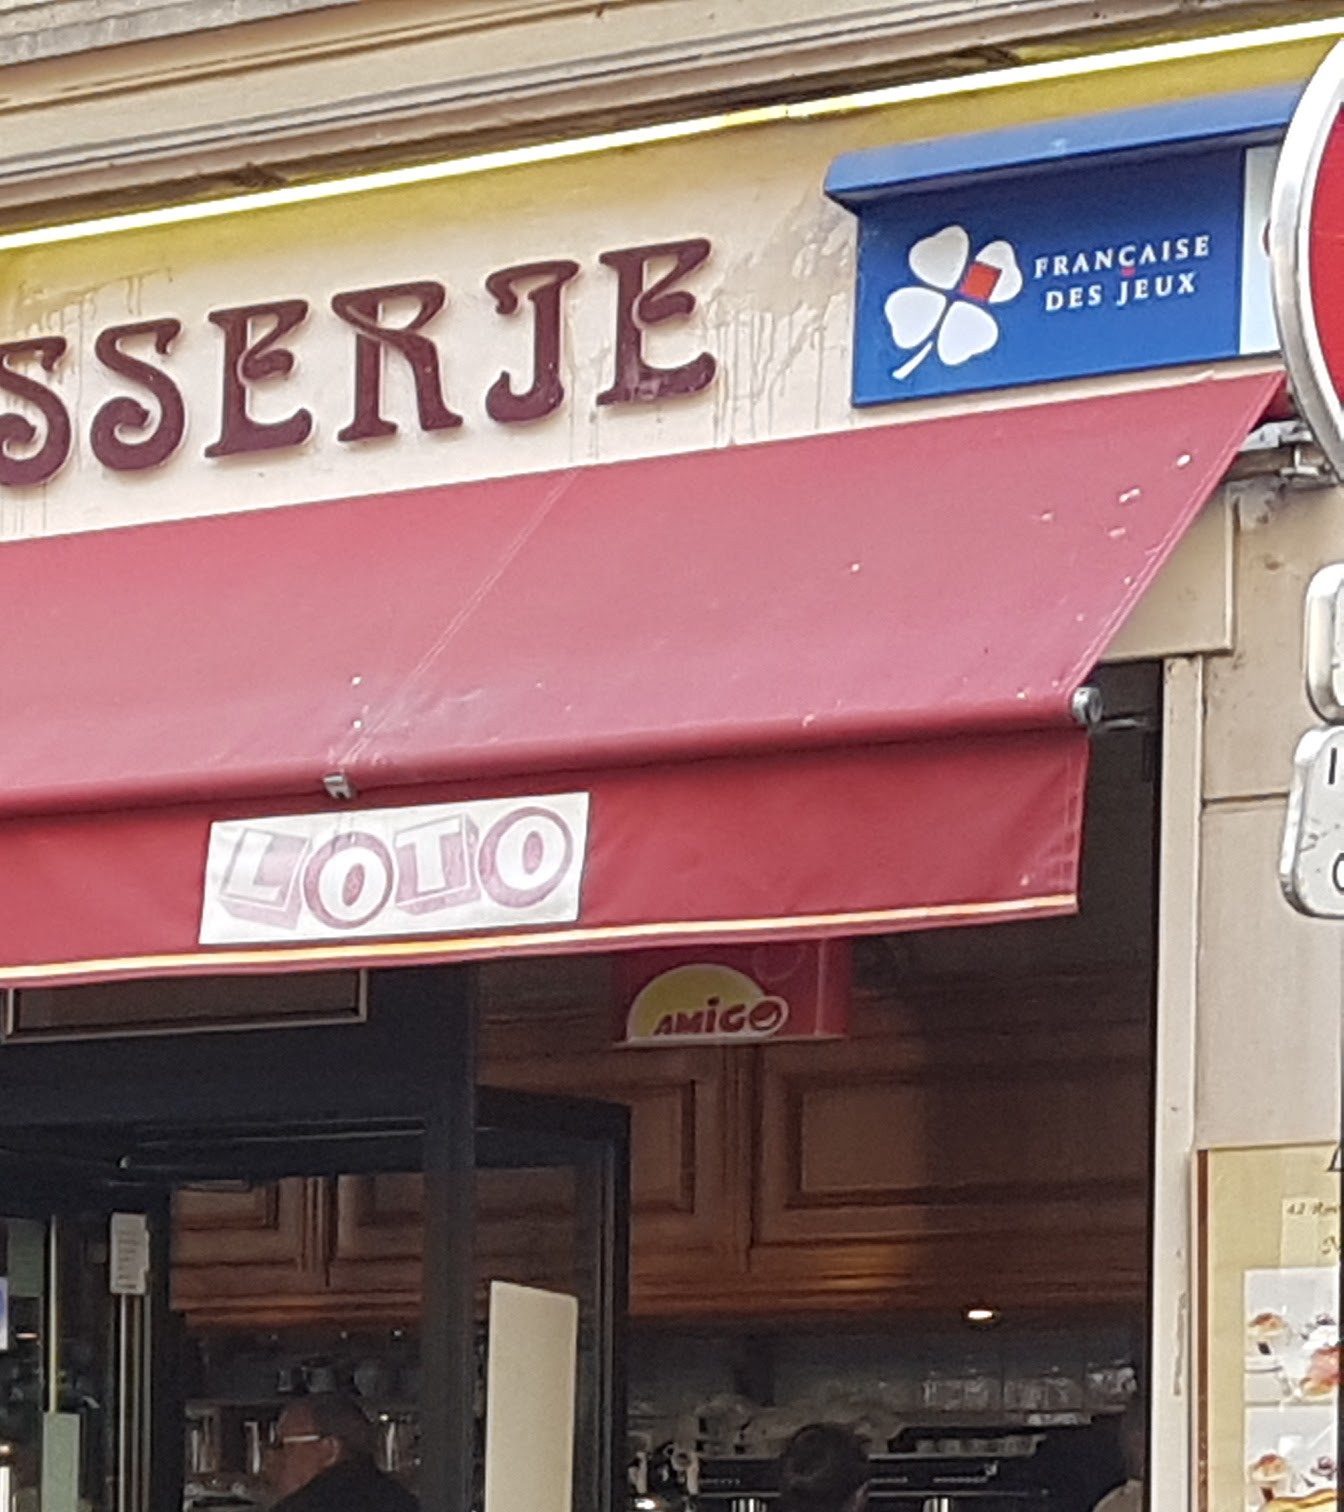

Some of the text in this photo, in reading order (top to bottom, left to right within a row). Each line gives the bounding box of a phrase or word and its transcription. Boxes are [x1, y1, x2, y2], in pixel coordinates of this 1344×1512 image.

[1034, 235, 1210, 279] FRANÇAISE
[1046, 272, 1196, 312] DES JEUX
[219, 804, 574, 931] LOTO
